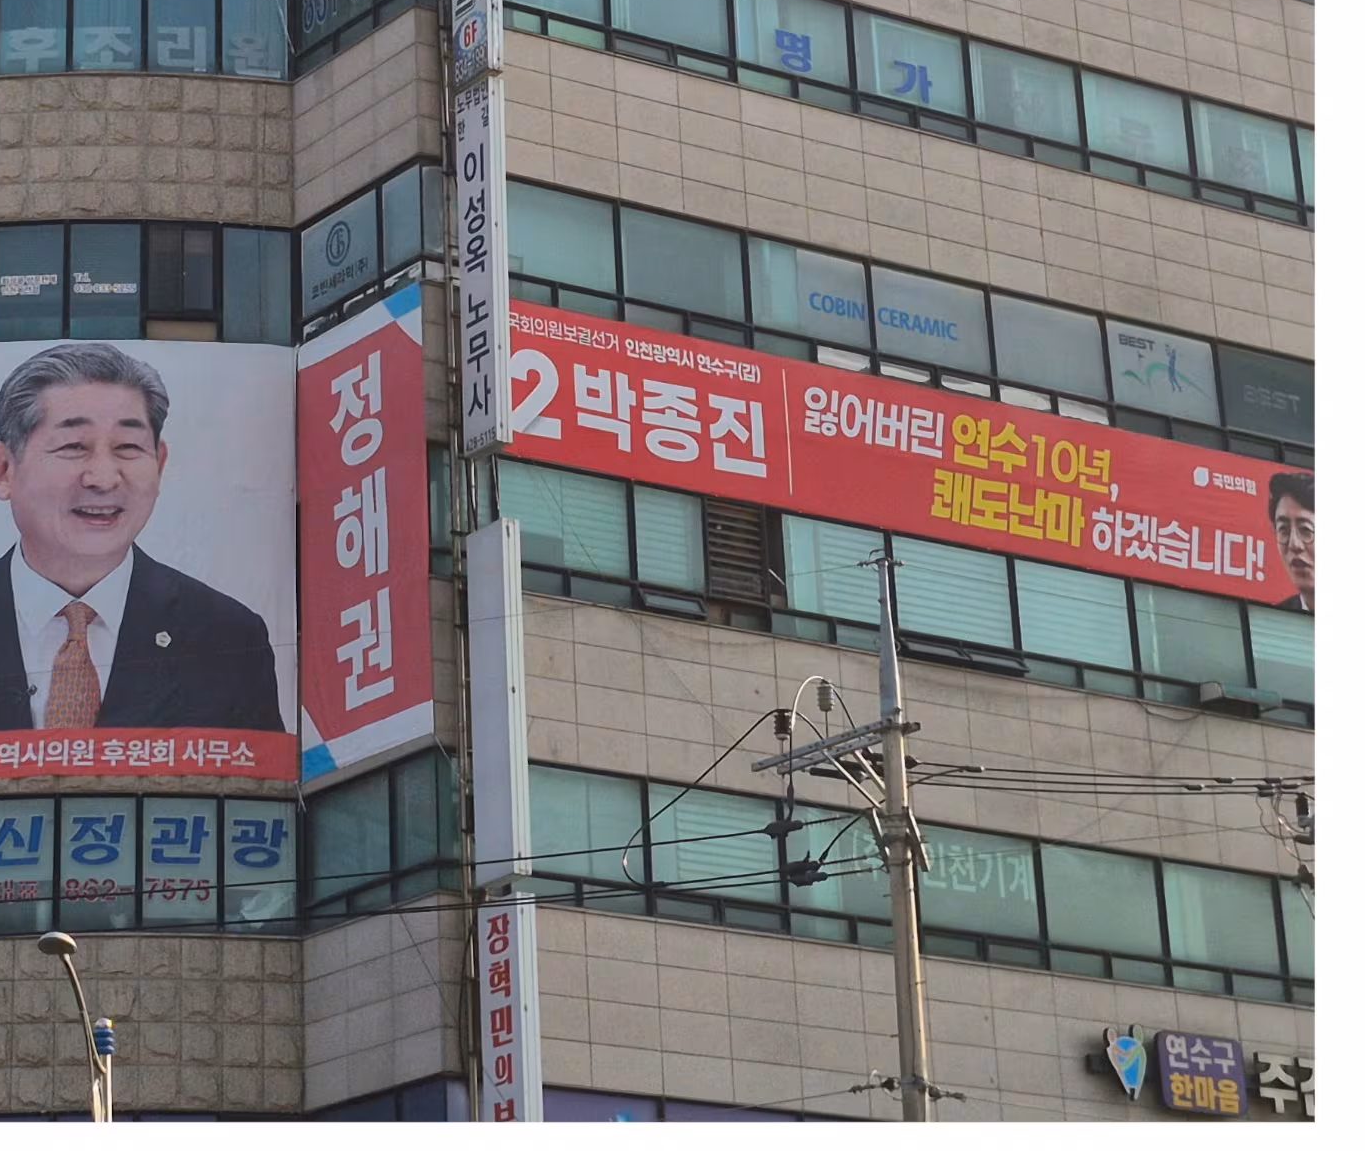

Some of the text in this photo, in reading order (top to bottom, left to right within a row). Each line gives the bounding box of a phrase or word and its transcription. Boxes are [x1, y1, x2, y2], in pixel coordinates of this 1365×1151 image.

[775, 28, 934, 106] 명가
[463, 143, 492, 417] 이성옥 노무사
[808, 290, 958, 342] COBIN CERAMIC
[509, 311, 761, 385] 국회의원보궐선거 인천광역시 연수구(갑)
[1118, 333, 1156, 351] BEST
[509, 348, 562, 441] 2
[573, 362, 768, 479] 박종진
[804, 386, 1119, 503] 잃어버린 연수10년,
[1213, 471, 1257, 497] 국민의힘
[329, 349, 397, 714] 정해권
[930, 468, 1266, 582] 쾌도난마 하겠습니다!
[100, 739, 175, 769] 후원회
[181, 738, 256, 768] 사무소
[64, 877, 212, 903] 862-7575
[1165, 1033, 1236, 1074] 연수구
[1169, 1072, 1241, 1115] 한마음
